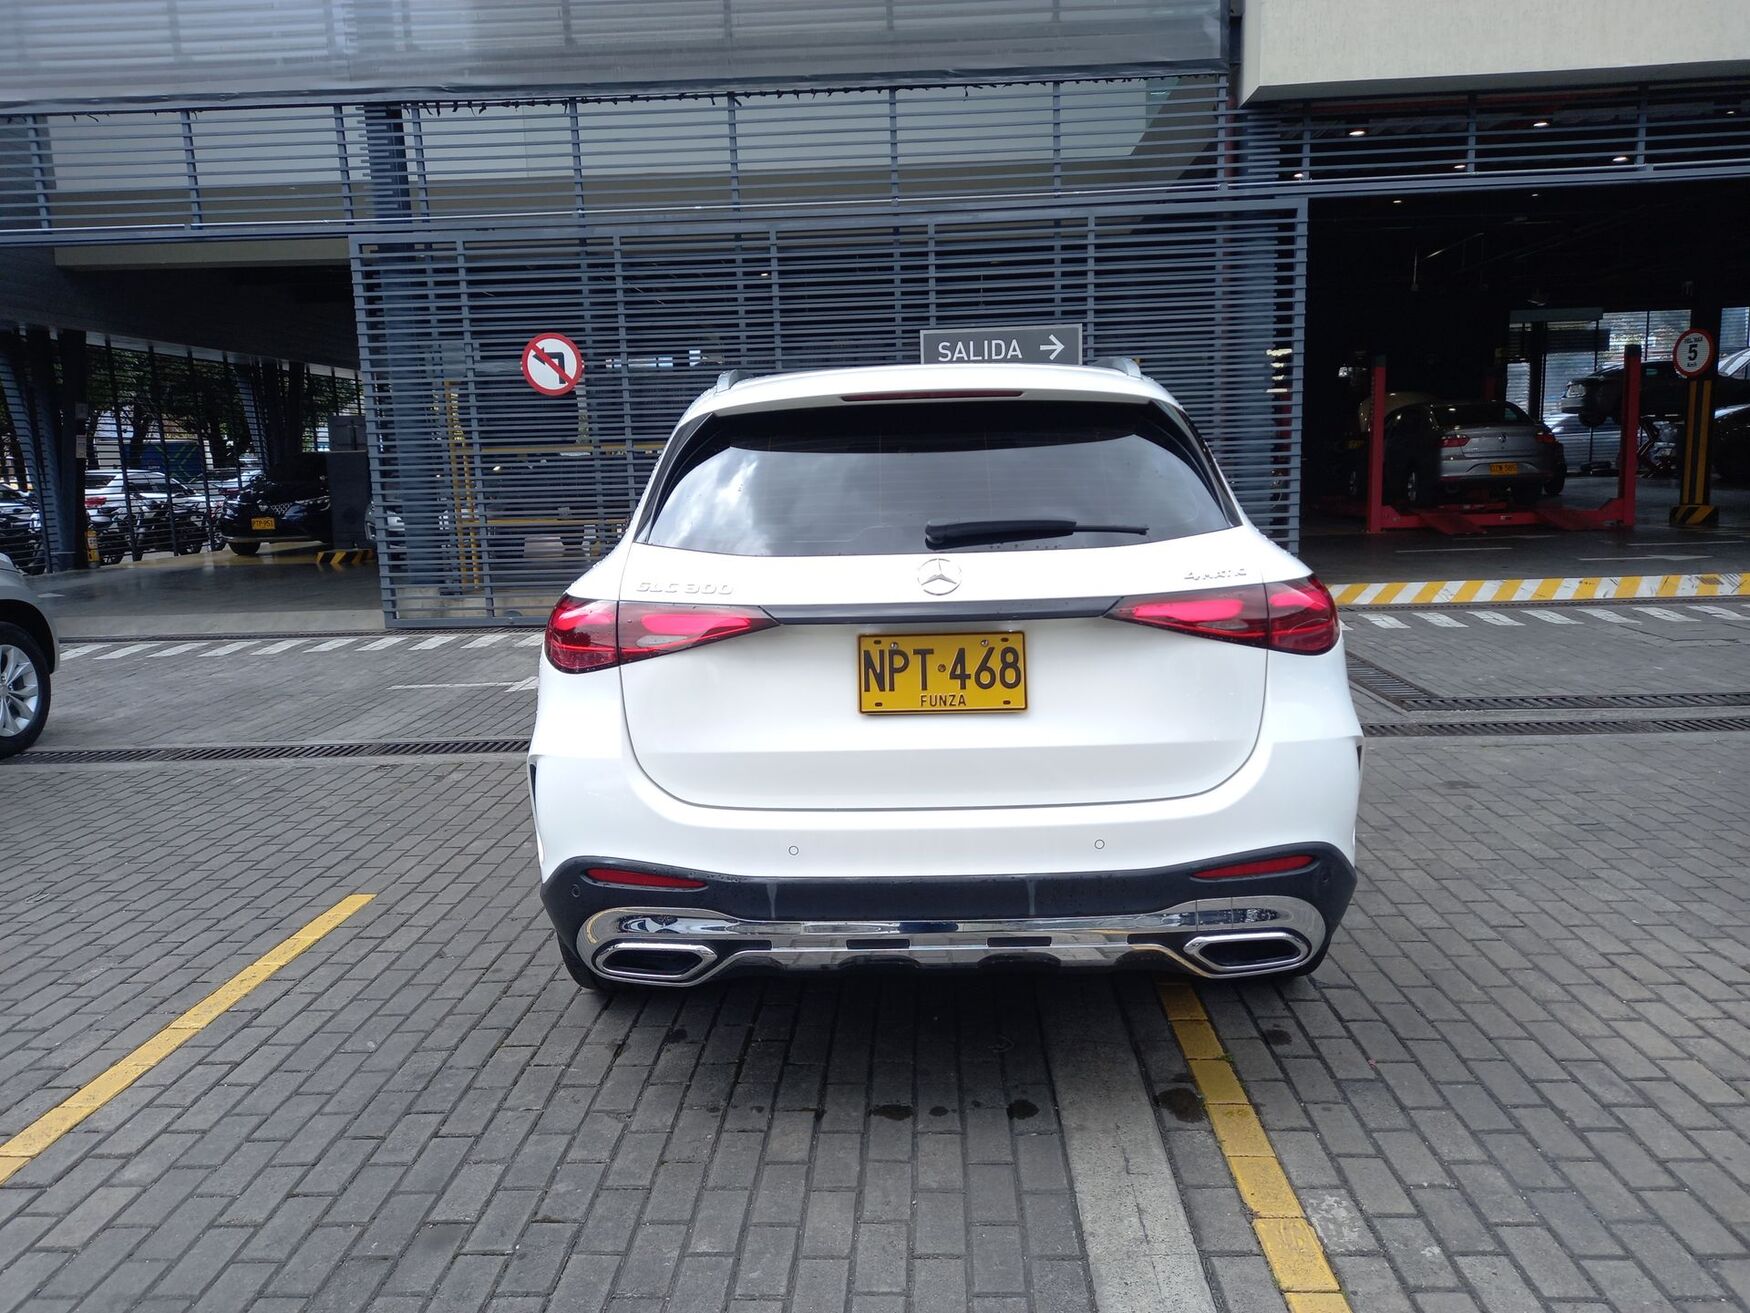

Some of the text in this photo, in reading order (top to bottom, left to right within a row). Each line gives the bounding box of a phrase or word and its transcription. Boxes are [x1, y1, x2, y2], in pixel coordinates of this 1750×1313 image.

[938, 339, 1022, 361] SALIDA
[1687, 343, 1698, 361] 5
[863, 646, 1021, 692] NPT 468
[920, 694, 967, 707] FUNZA
